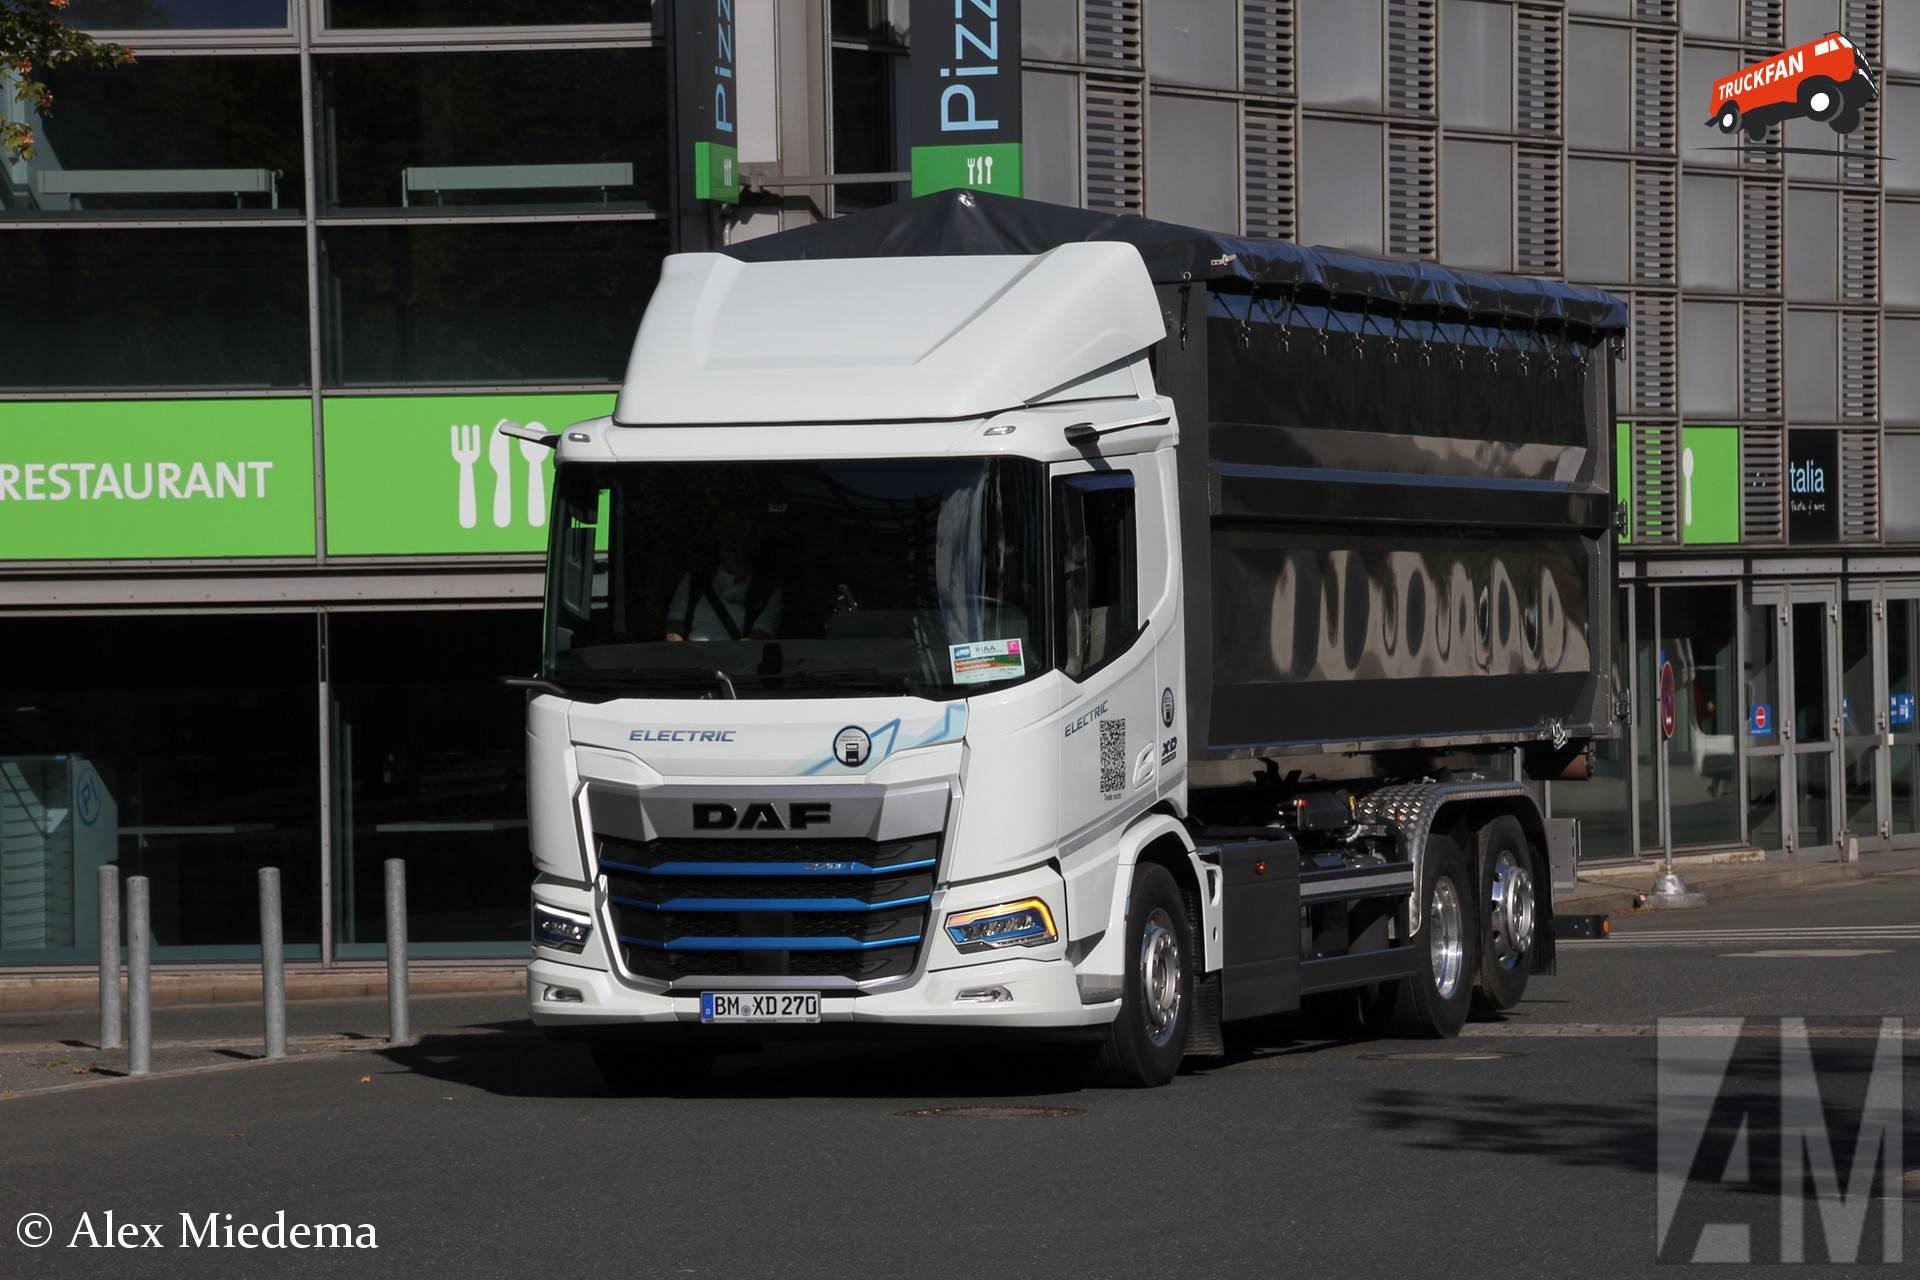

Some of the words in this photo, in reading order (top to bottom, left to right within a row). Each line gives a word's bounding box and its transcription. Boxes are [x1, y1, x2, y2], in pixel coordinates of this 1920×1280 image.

[0, 461, 273, 501] RESTAURANT
[1790, 460, 1825, 493] talia
[1064, 700, 1109, 738] ELECTRIC
[629, 730, 737, 742] ELECTRIC
[1161, 736, 1178, 758] XD
[693, 802, 832, 830] DAF
[714, 996, 739, 1015] BM
[753, 996, 777, 1015] XD
[782, 996, 817, 1015] 270
